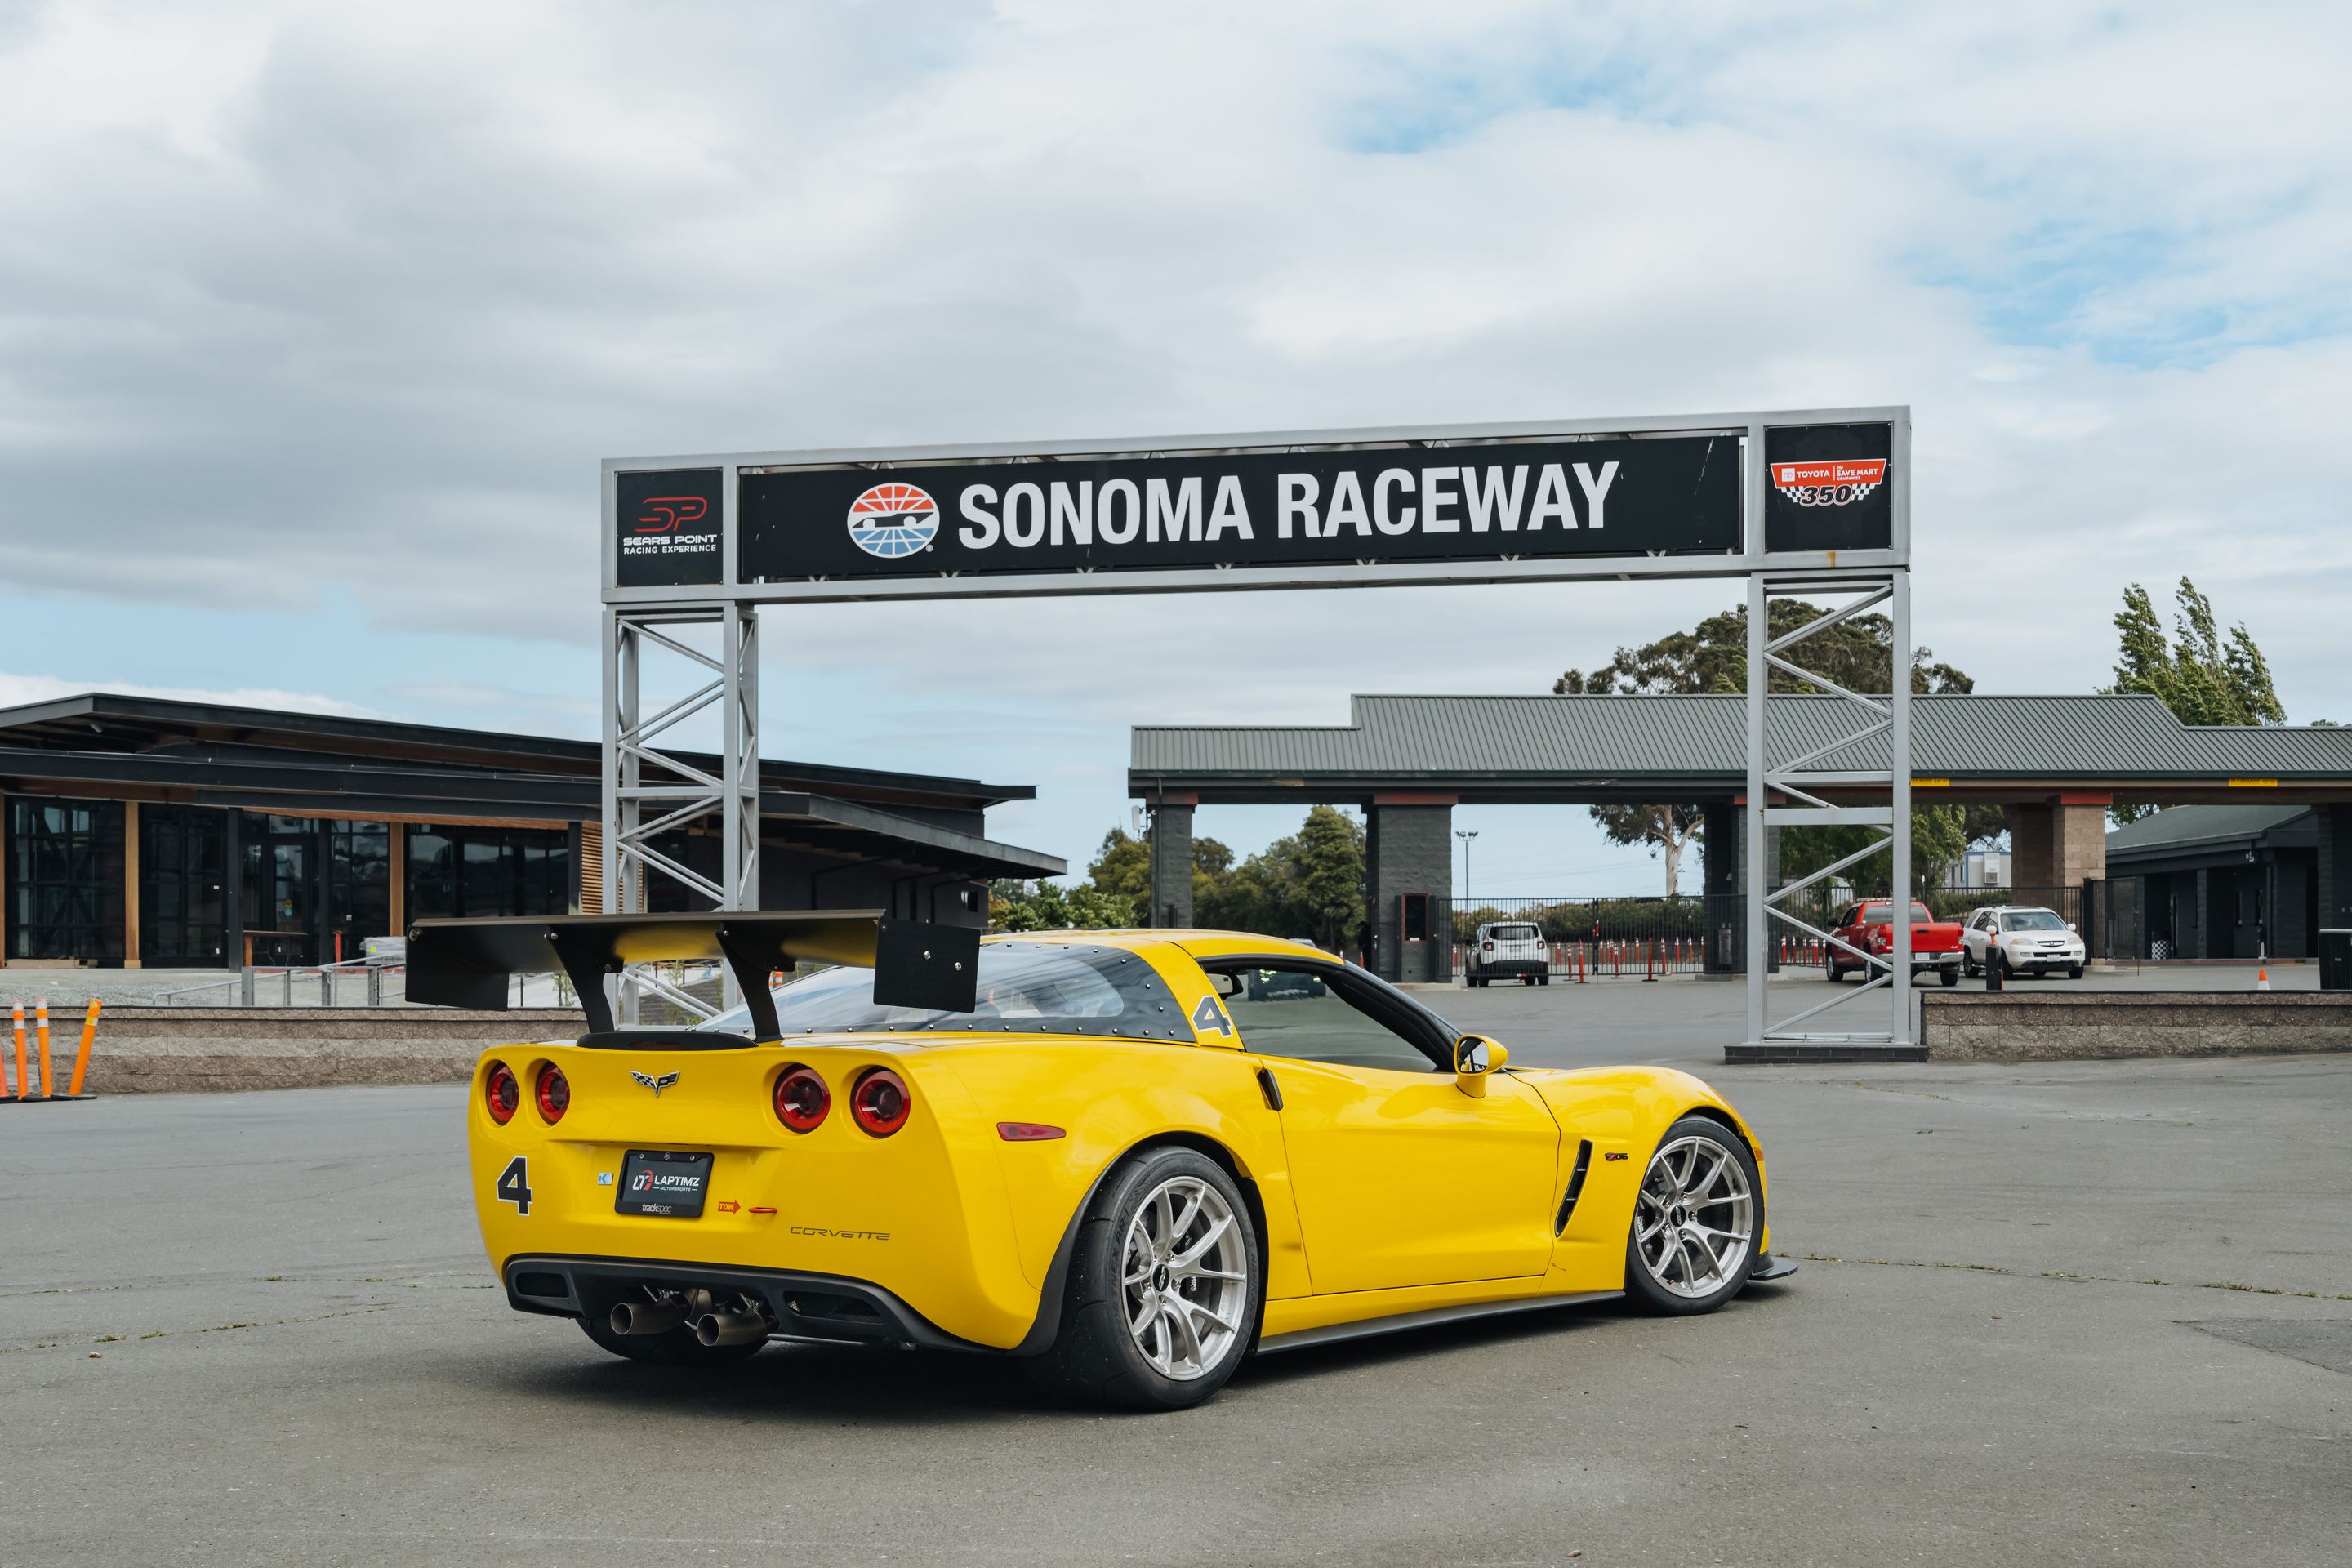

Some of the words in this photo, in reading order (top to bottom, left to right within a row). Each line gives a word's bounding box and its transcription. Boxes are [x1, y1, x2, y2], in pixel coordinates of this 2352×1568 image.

[1797, 470, 1830, 479] TOYOTA
[1799, 484, 1853, 506] 350
[959, 474, 1254, 549] SONOMA
[1277, 461, 1621, 539] RACEWAY
[623, 536, 670, 546] SEARS
[675, 534, 718, 545] POINT
[624, 546, 658, 555] RACING
[662, 544, 717, 554] EXPERIENCE
[1192, 995, 1234, 1038] 4
[497, 1156, 532, 1216] 4
[654, 1175, 701, 1187] LAPTIMZ
[642, 1203, 672, 1213] trackspec
[719, 1203, 735, 1211] TOW
[791, 1227, 890, 1240] CORVETTE
